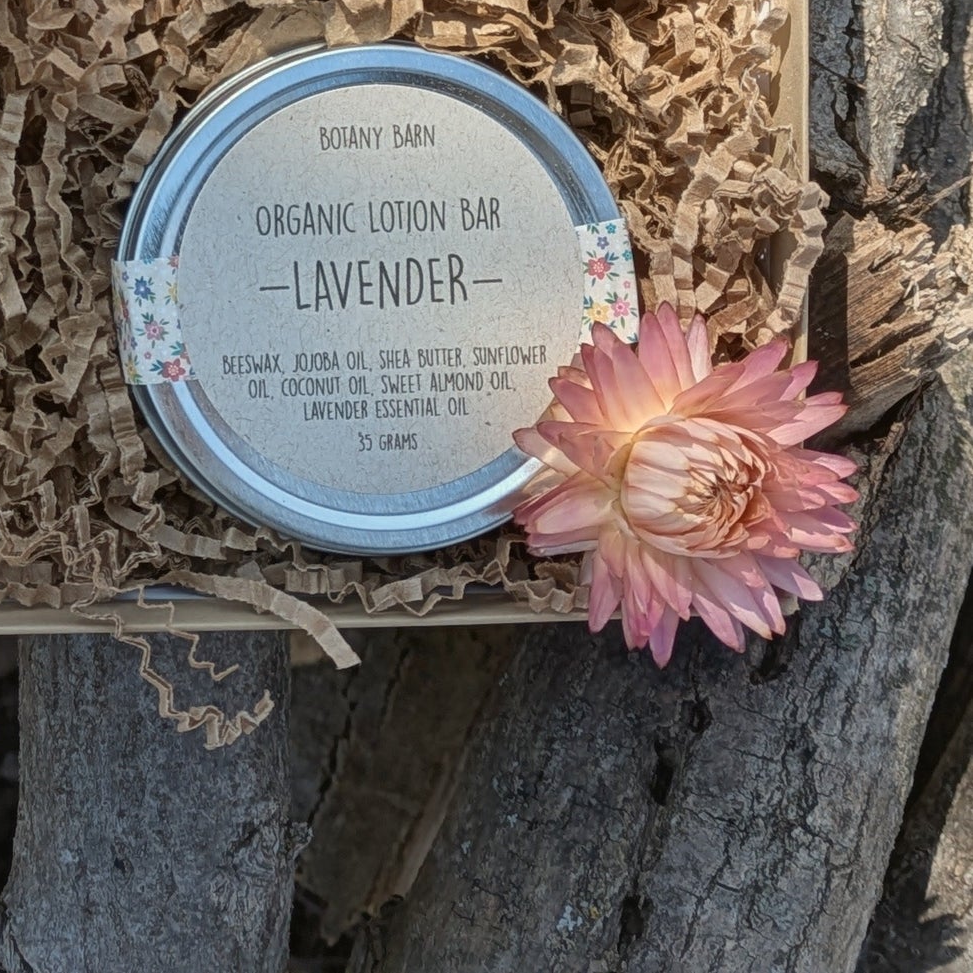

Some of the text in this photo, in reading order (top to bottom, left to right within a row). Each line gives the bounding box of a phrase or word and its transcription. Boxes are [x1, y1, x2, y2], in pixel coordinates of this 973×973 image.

[319, 123, 435, 151] BOTANY BARN
[256, 196, 501, 237] ORGANIC LOTION BAR
[222, 345, 547, 375] BEESWAX, JOJOBA OIL, SHEA BUTTER, SUNFLOWER
[248, 371, 517, 400] OIL, COCONUT OIL, SWEET ALMOND OIL,
[303, 397, 469, 421] LAVENDER ESSENTIAL OIL
[358, 431, 418, 451] 35 GRAMS
